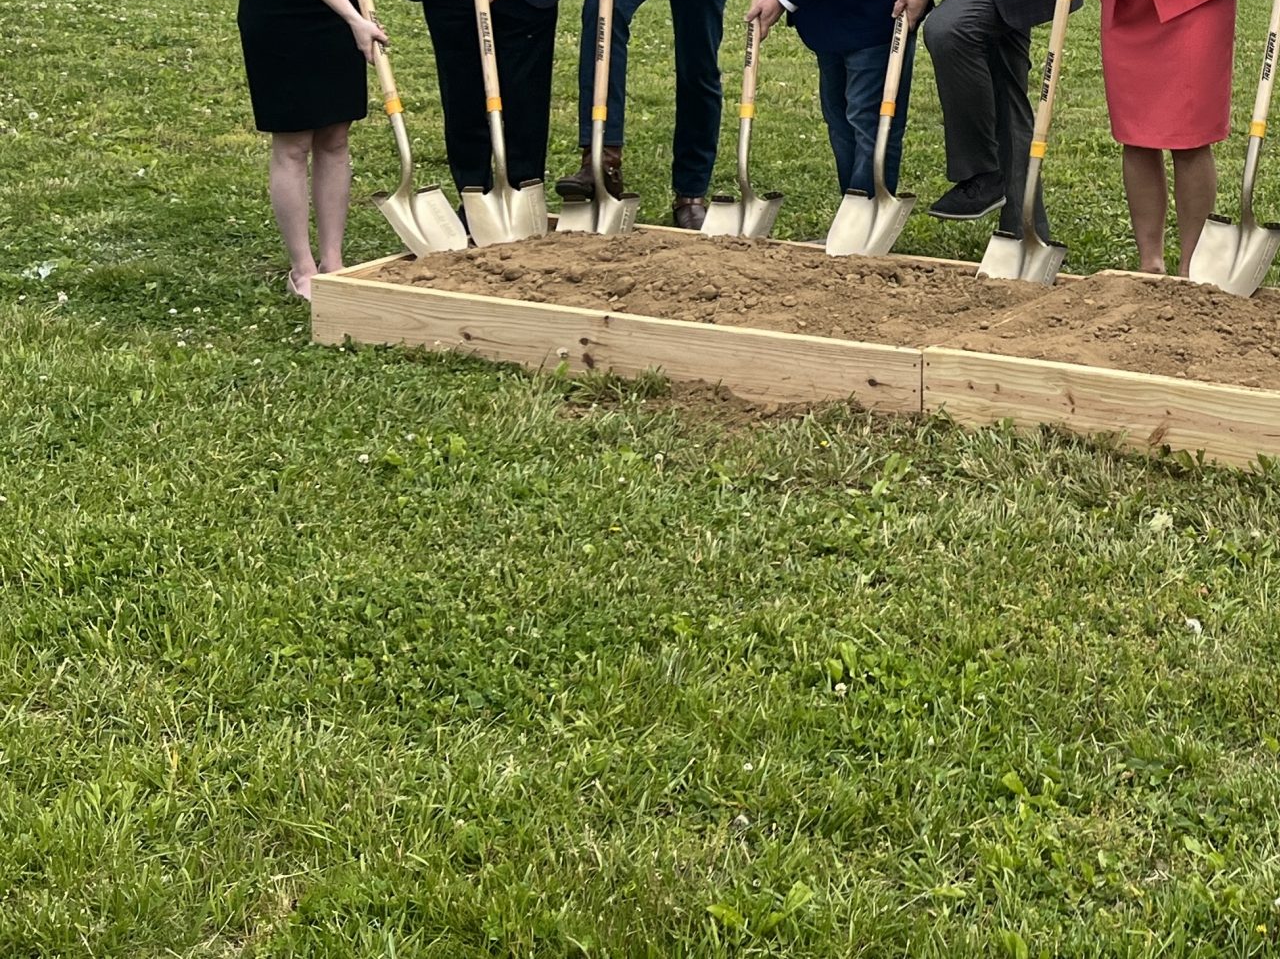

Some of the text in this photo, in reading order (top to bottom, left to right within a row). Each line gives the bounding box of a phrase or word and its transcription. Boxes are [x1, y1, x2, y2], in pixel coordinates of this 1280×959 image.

[891, 36, 901, 54] TRUE
[1261, 32, 1277, 81] TRUE TEMPER
[1040, 51, 1055, 102] TRUE TEMPER
